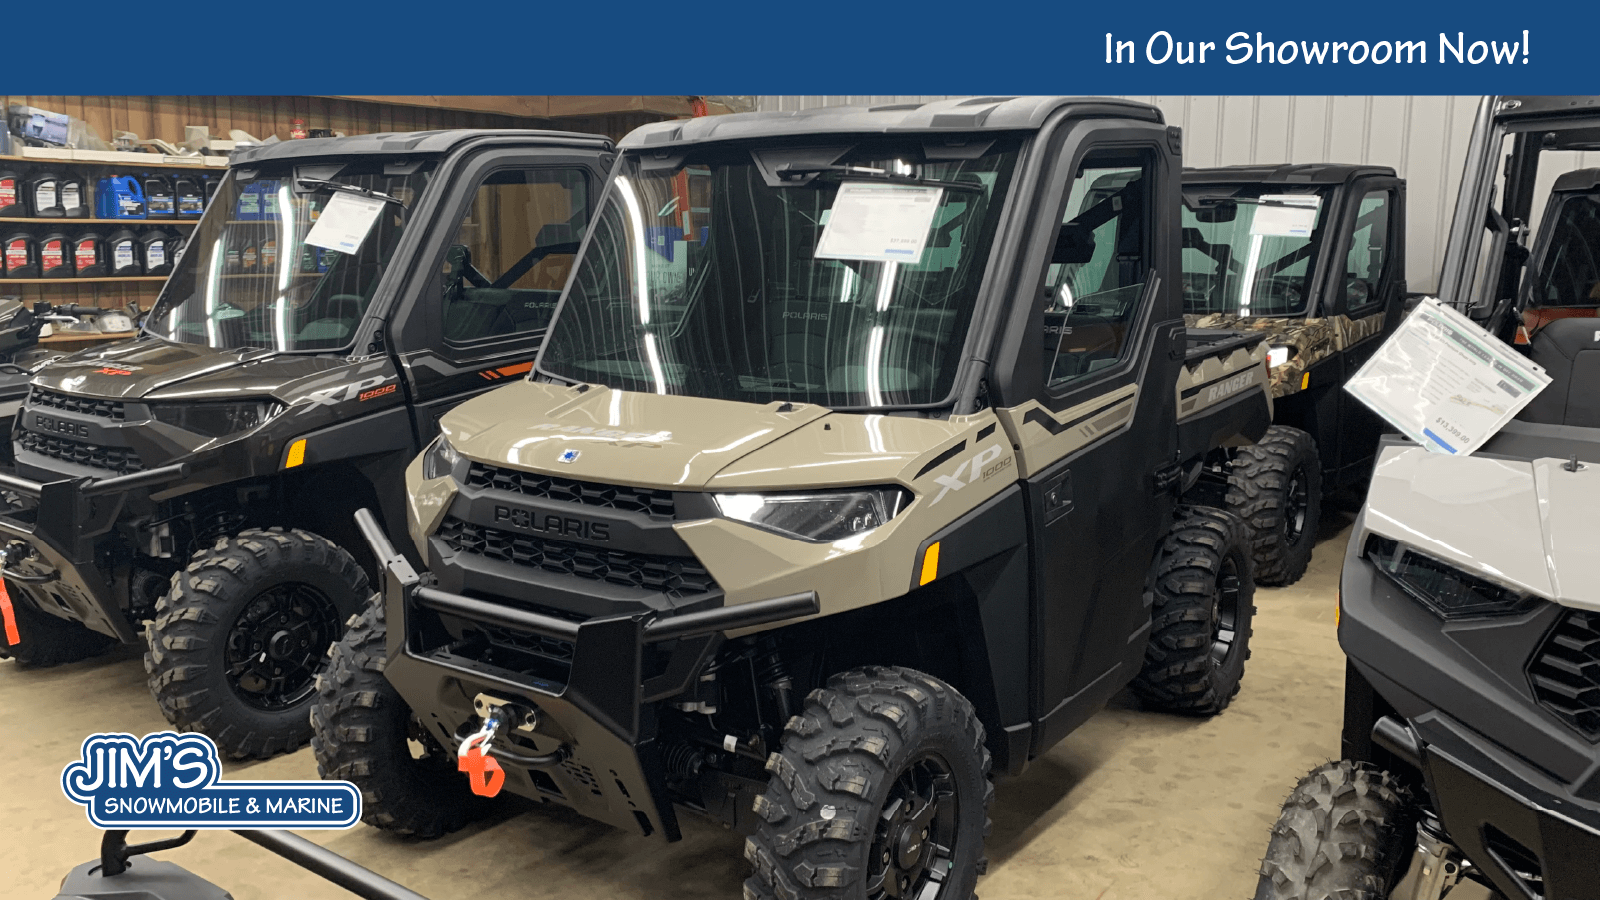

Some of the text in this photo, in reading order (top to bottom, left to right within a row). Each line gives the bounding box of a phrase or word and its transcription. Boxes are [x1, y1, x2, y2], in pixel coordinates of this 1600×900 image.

[782, 311, 828, 320] POLARIS
[295, 375, 396, 417] XP 1000
[1208, 372, 1254, 402] RANGER
[36, 416, 89, 439] POLARIS
[928, 444, 1002, 508] XP
[983, 456, 1012, 479] 1000
[494, 505, 611, 541] POLARIS
